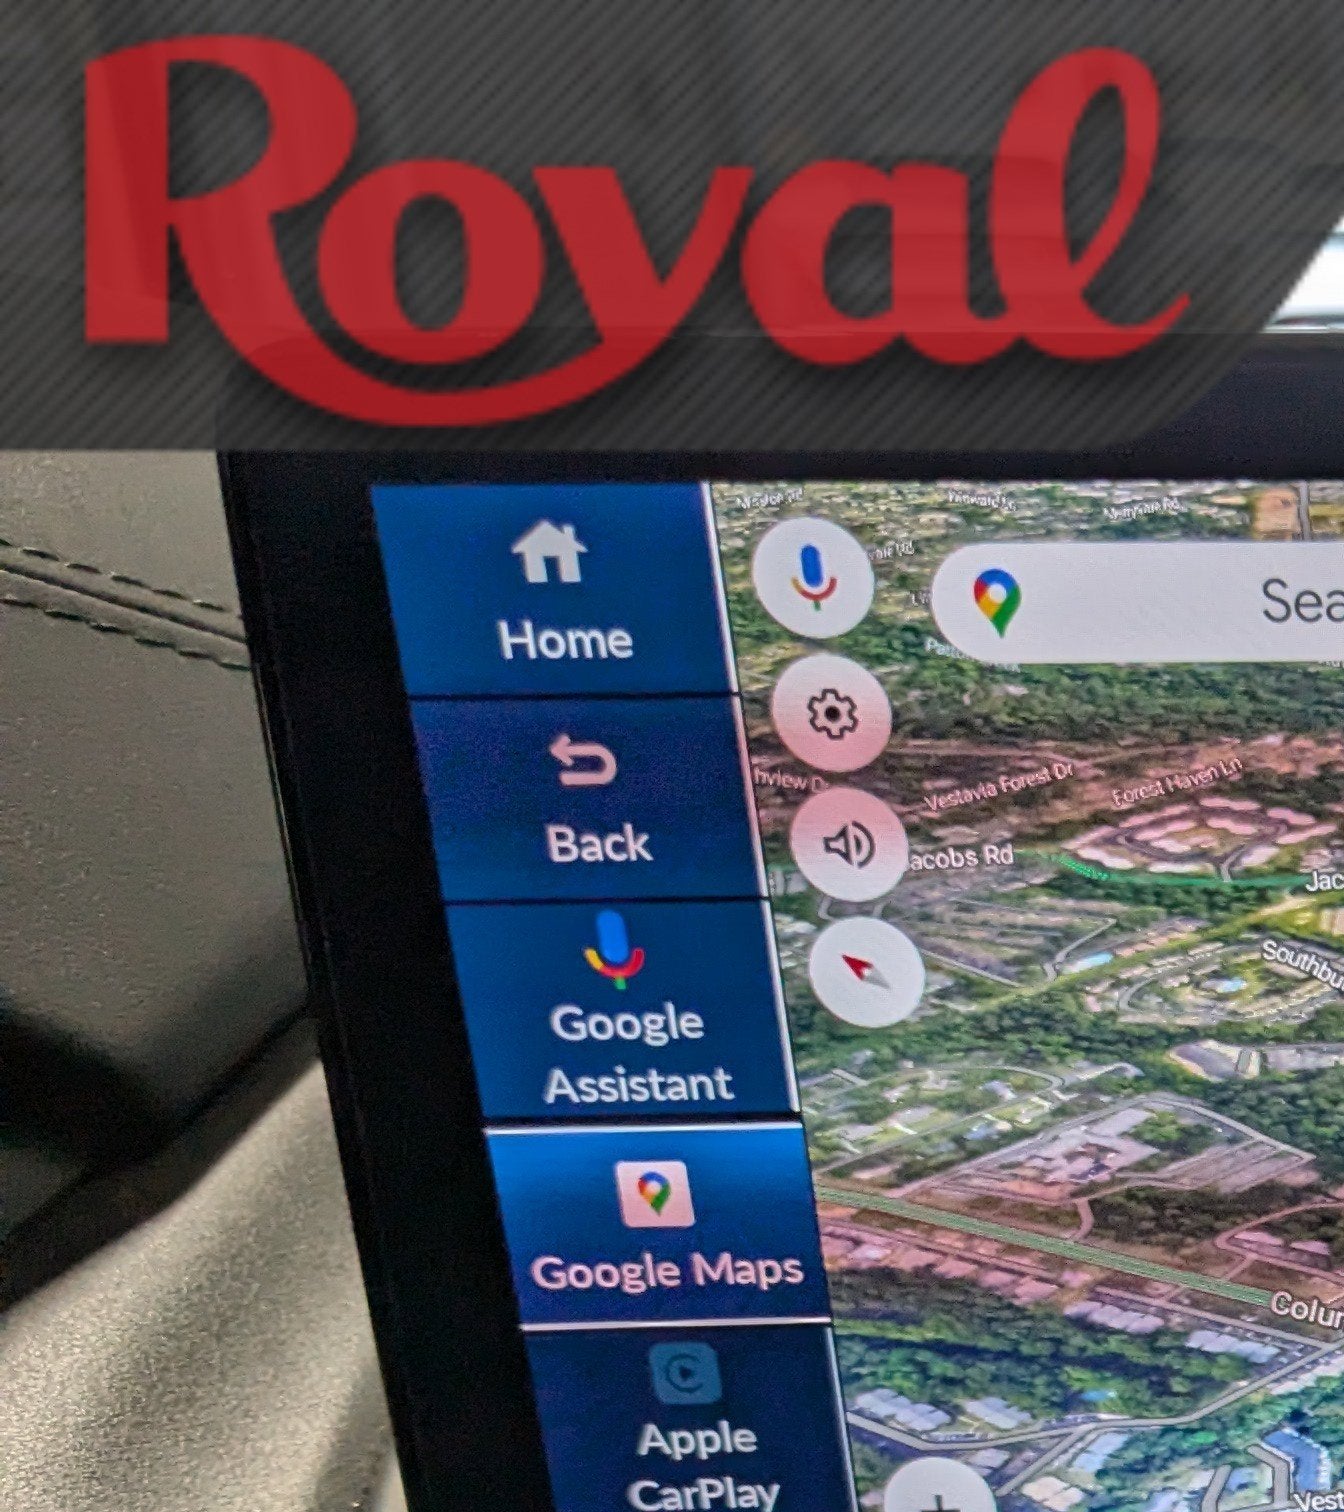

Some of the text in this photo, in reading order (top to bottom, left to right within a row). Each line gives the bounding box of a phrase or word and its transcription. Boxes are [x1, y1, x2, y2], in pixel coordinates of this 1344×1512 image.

[498, 620, 633, 661] Home
[545, 822, 654, 864] Back
[906, 843, 1014, 871] acobs Rd
[549, 1001, 705, 1048] Google
[545, 1065, 736, 1105] Assistant
[531, 1252, 805, 1295] Google Maps
[635, 1420, 758, 1461] Apple
[627, 1476, 781, 1512] CarPlay
